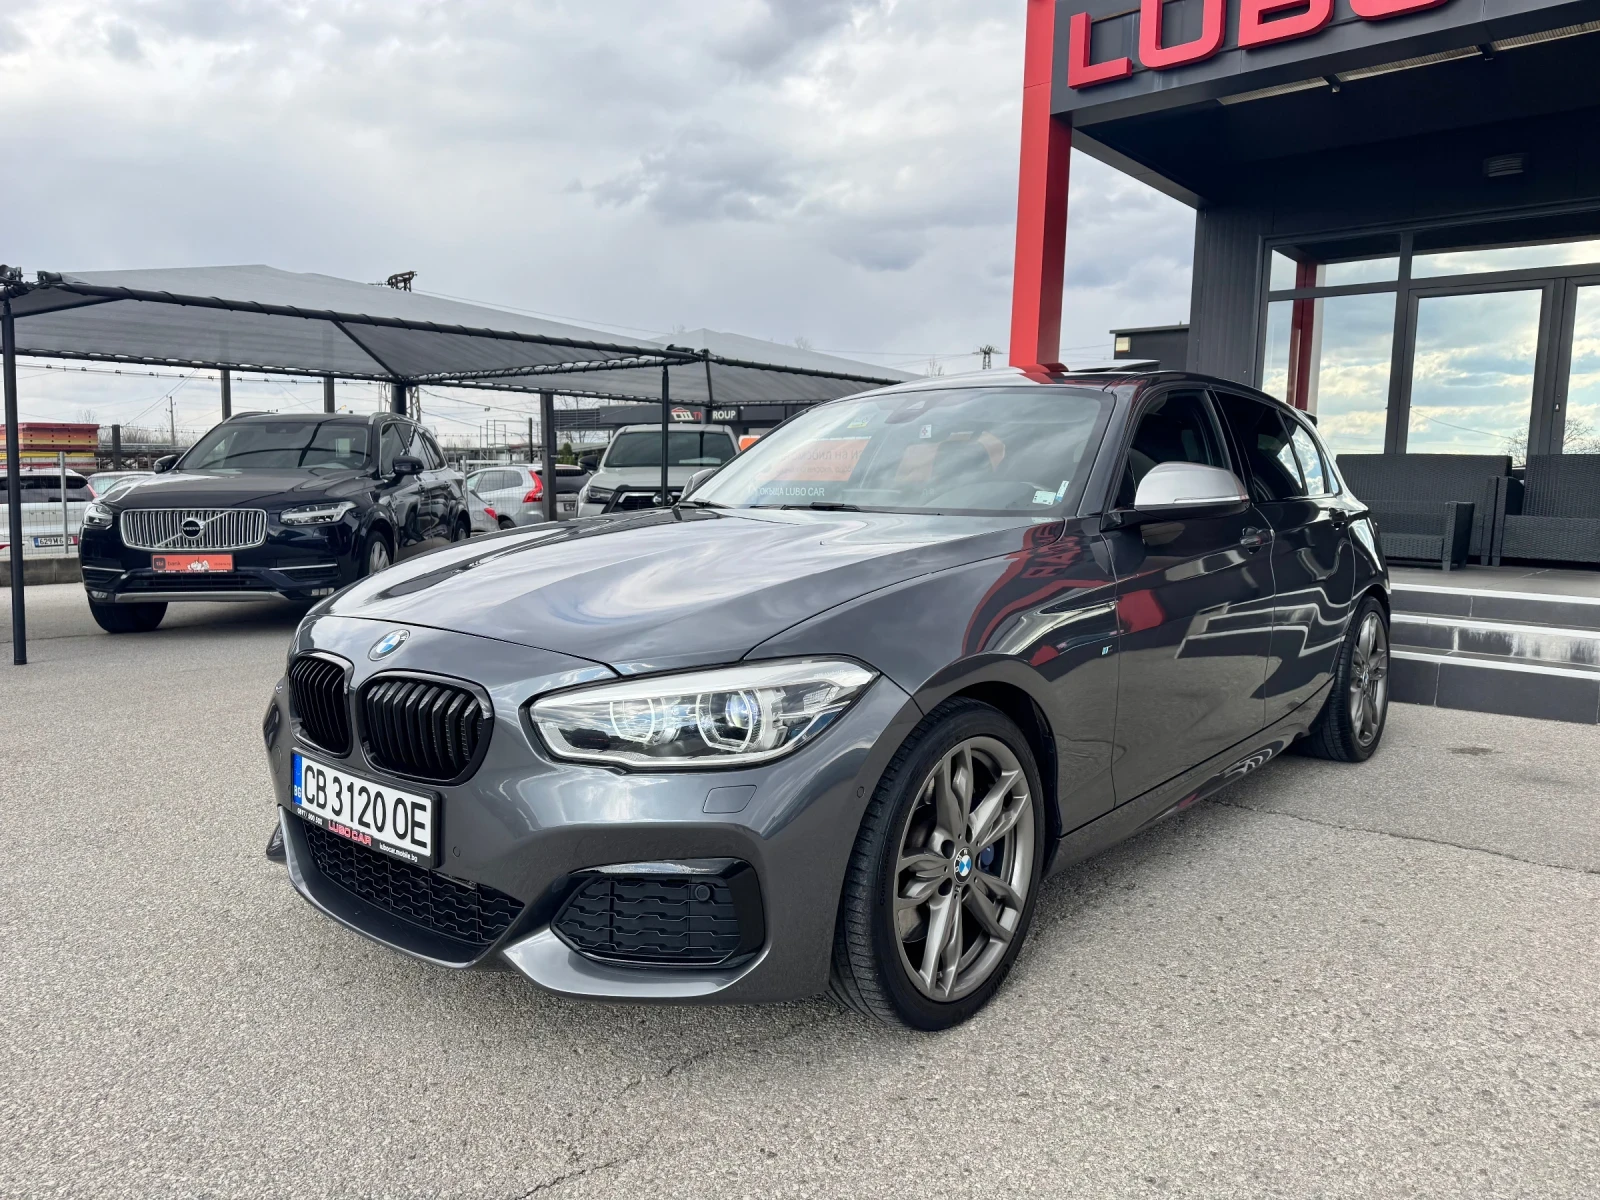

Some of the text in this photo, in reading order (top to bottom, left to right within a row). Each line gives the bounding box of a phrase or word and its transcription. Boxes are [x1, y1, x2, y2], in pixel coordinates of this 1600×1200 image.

[712, 410, 736, 420] ROUP
[785, 487, 807, 496] LUBO
[808, 487, 825, 497] CAR
[293, 785, 302, 797] BG
[303, 764, 428, 849] CB 3120 OE
[328, 820, 373, 847] LUBO CAR
